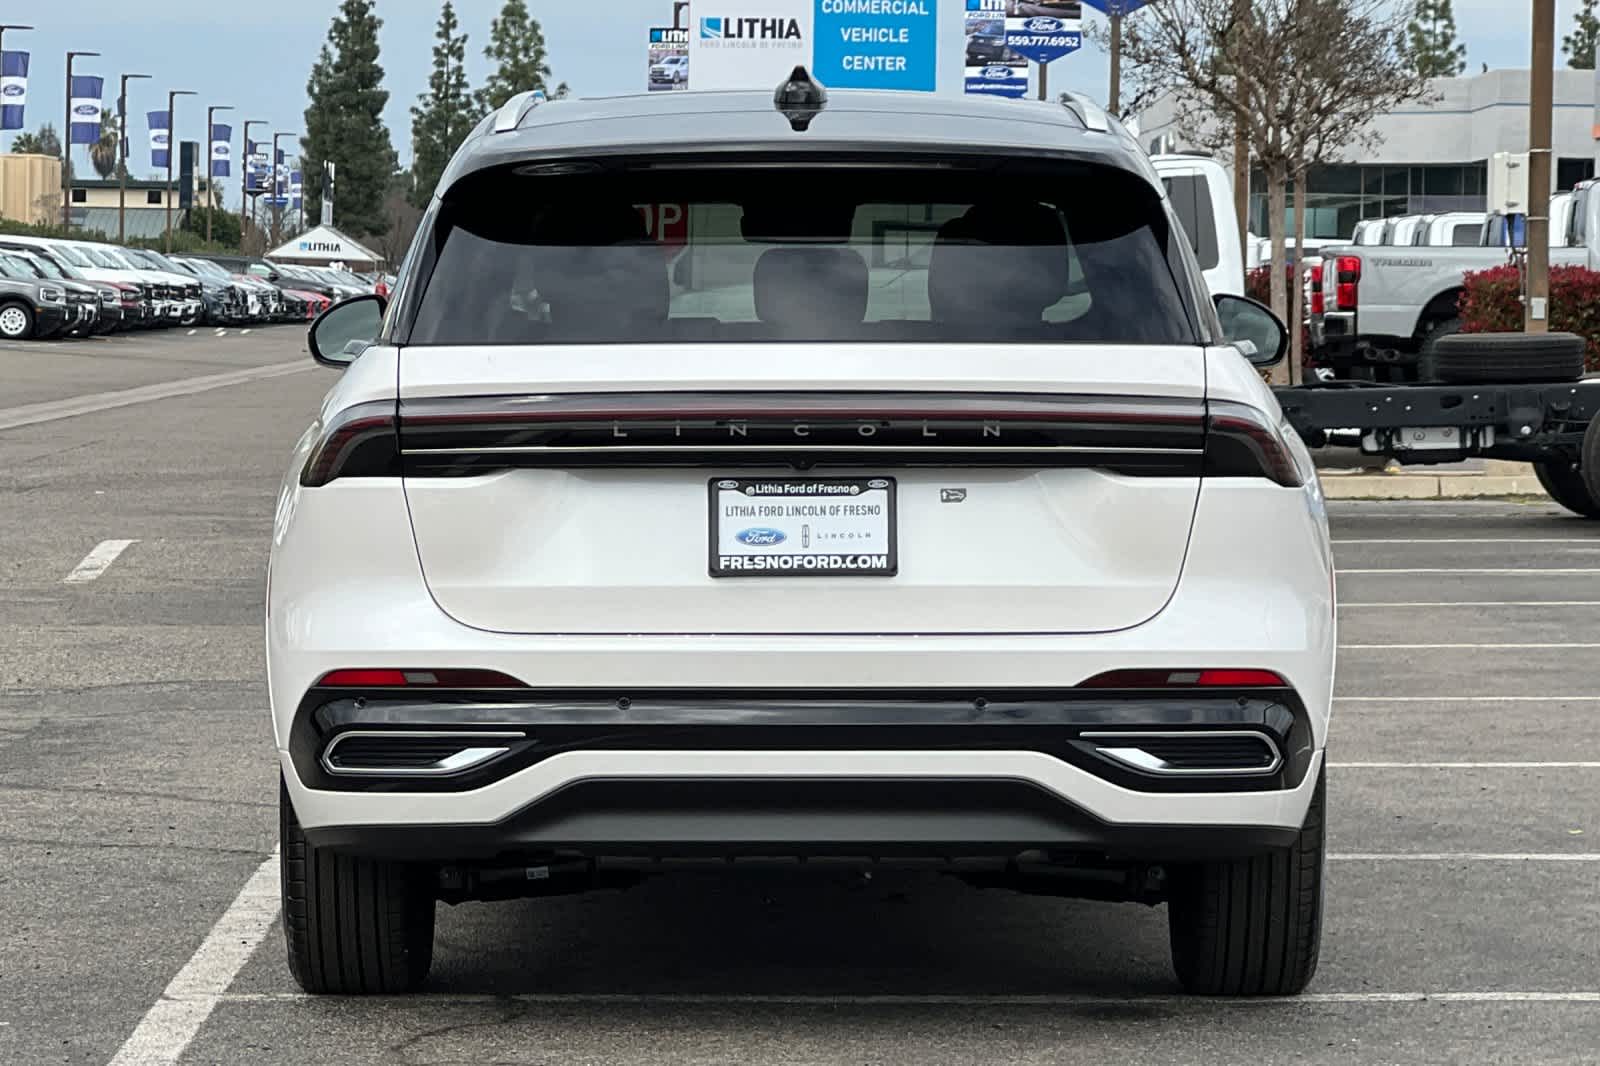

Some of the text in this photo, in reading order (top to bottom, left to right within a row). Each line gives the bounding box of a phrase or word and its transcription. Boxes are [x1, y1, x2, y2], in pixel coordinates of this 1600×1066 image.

[821, 0, 929, 15] COMMERCIAL
[723, 17, 802, 39] LITHIA
[840, 27, 909, 43] VEHICLE
[1007, 35, 1079, 47] 559.777.6952
[842, 55, 907, 71] CENTER
[308, 243, 341, 252] LITHIA
[613, 424, 1001, 438] LINCOLN
[756, 484, 850, 494] Lithia Ford of Fresno
[725, 504, 881, 517] LITHIA FORD LINCOLN OF FRESNO
[719, 555, 888, 570] FRESNOFORD.COM
